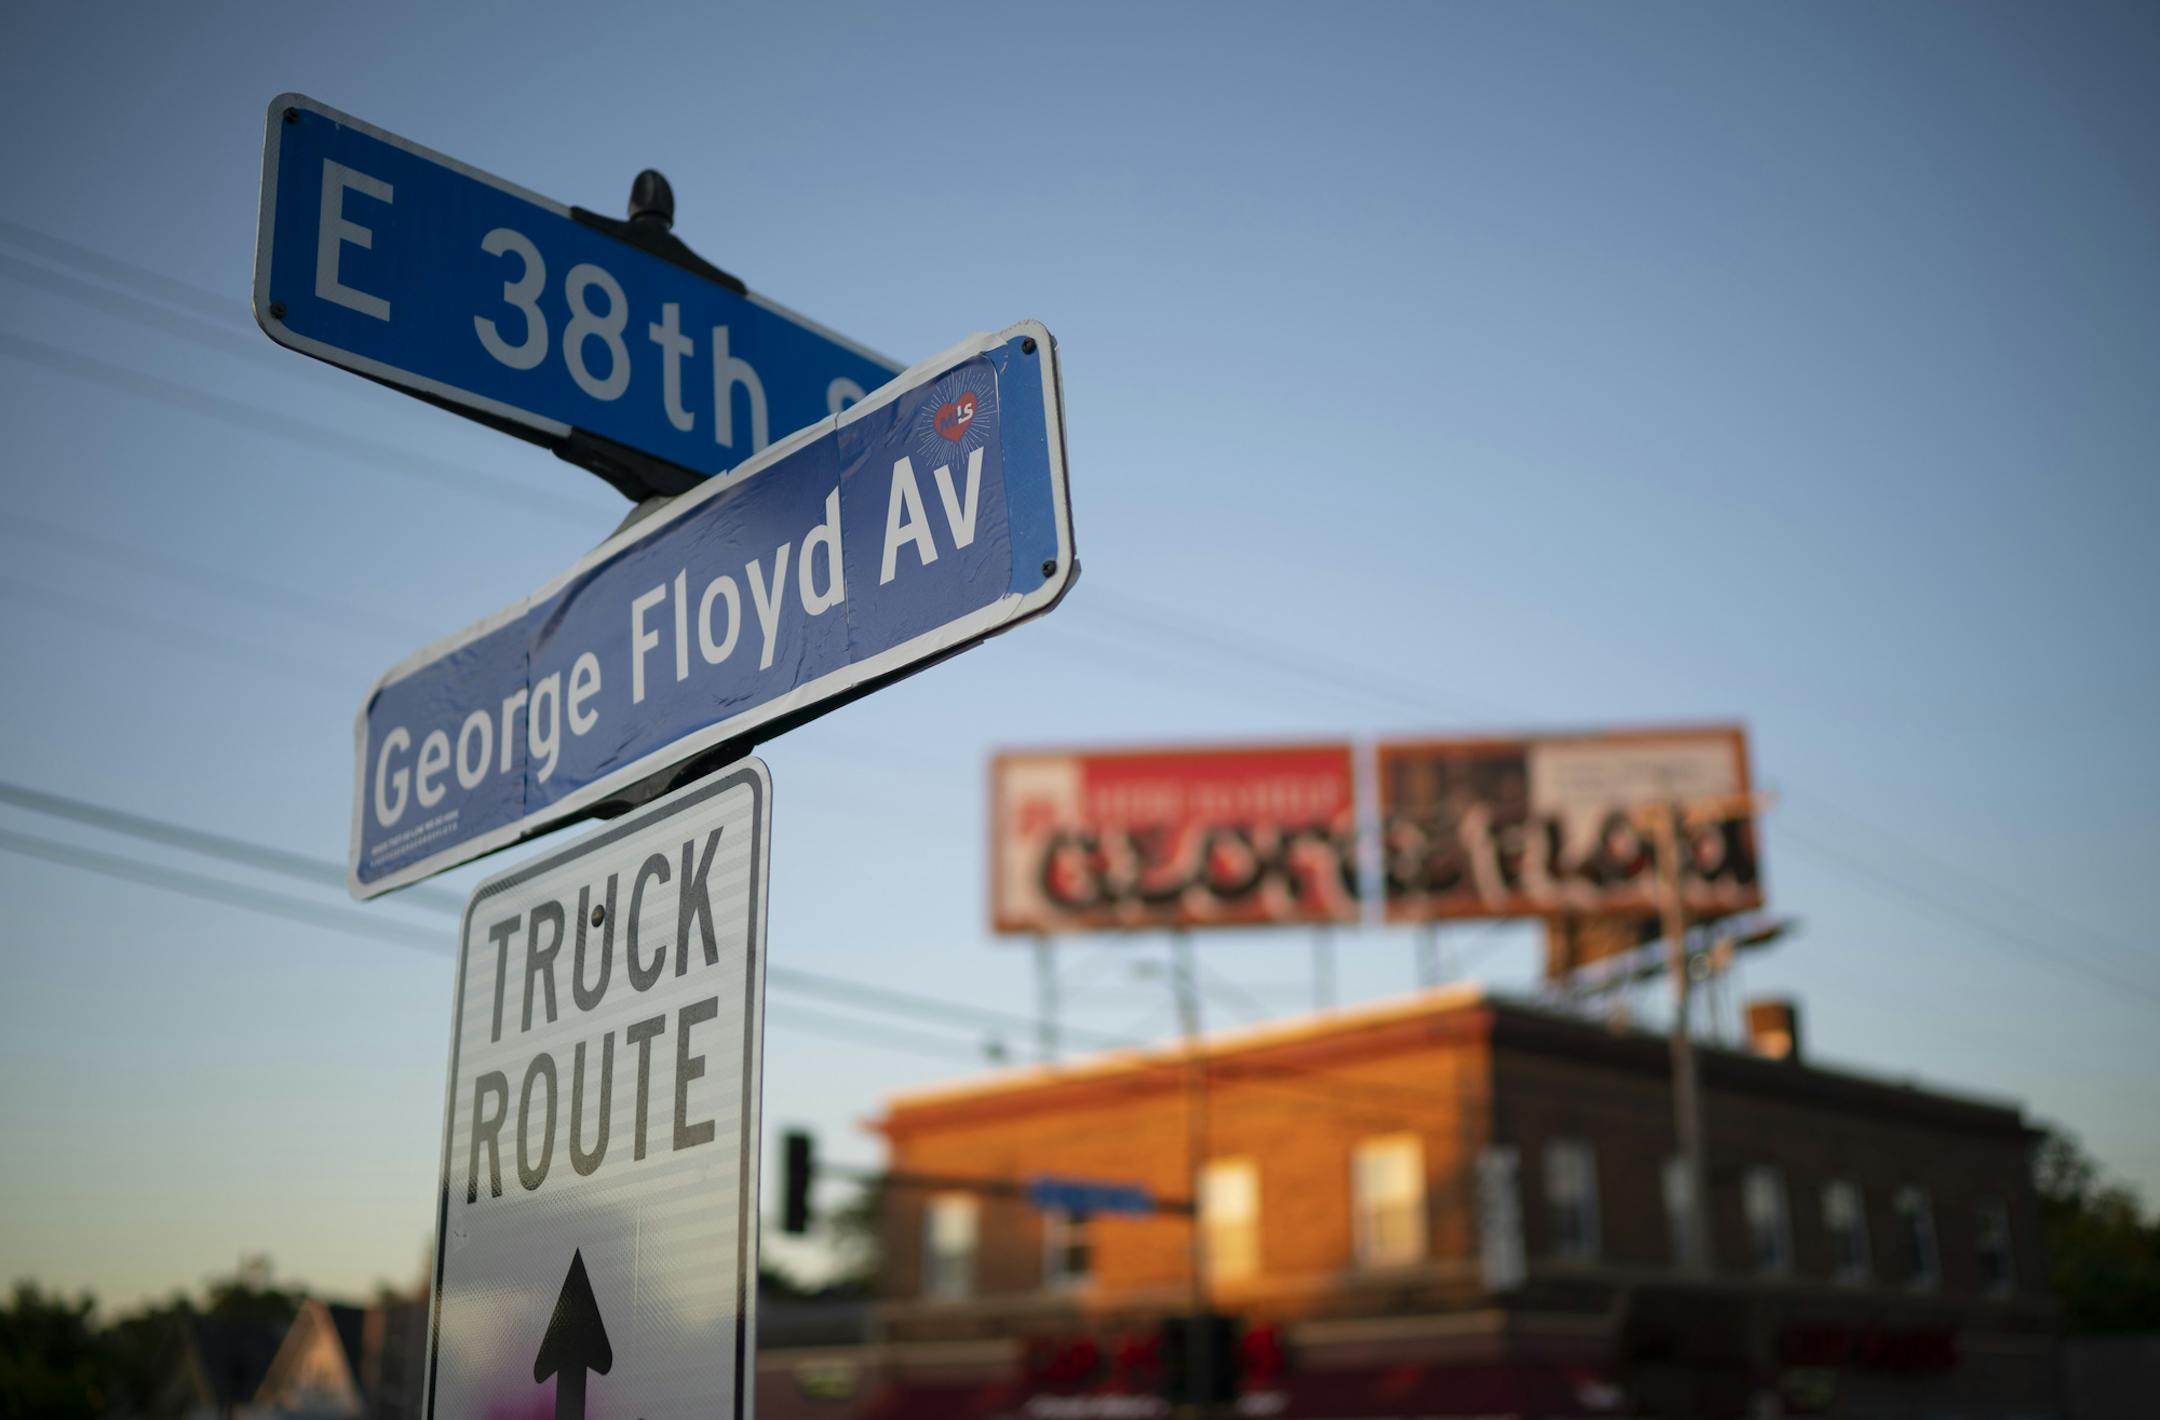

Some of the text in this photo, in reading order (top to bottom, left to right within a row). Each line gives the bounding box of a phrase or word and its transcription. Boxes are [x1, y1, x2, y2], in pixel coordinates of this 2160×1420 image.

[315, 157, 769, 456] E 38th
[374, 446, 985, 828] George Floyd Av
[487, 826, 725, 1044] TRUCK
[466, 995, 719, 1205] ROUTE
